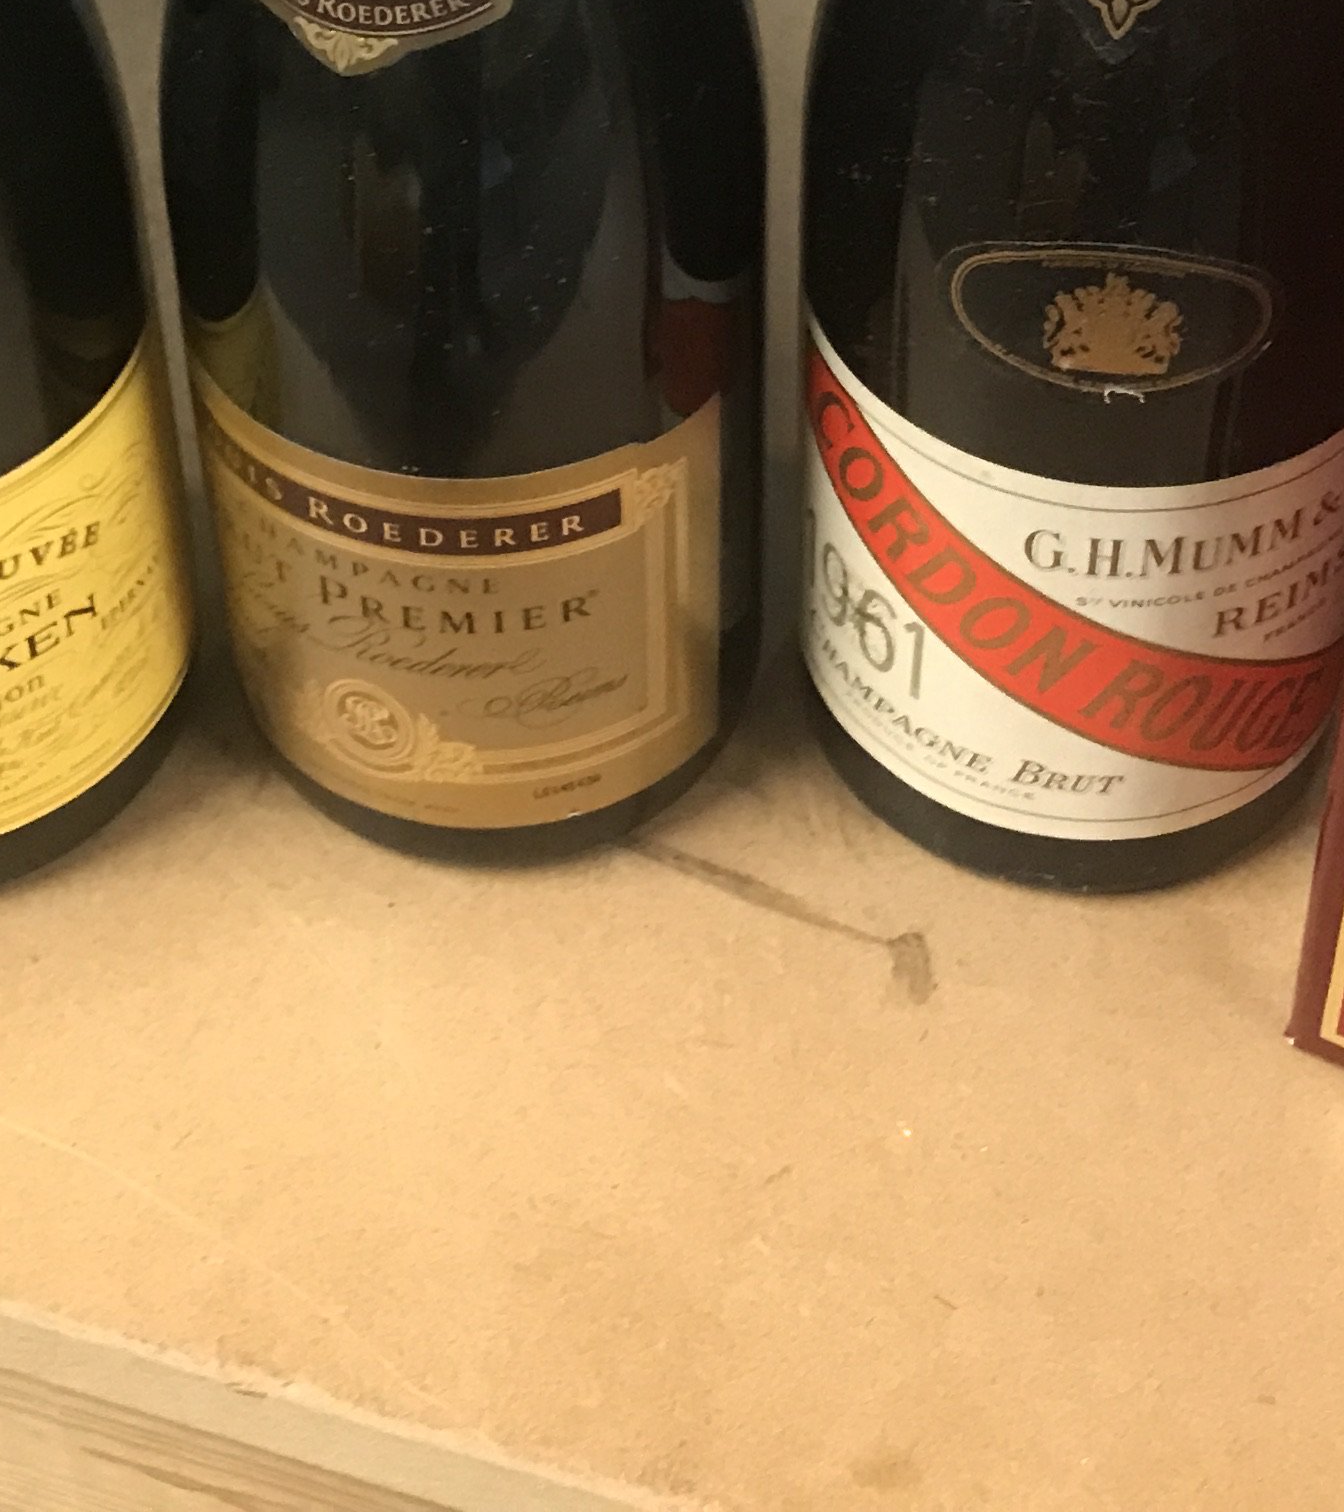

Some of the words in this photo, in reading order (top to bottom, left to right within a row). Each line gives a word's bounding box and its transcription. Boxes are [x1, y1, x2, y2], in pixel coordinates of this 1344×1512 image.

[306, 495, 586, 549] ROEDERER
[1023, 508, 1304, 579] G.H.MUMM
[818, 391, 1098, 699] CORDON
[1080, 658, 1324, 754] ROUGE
[1107, 589, 1205, 609] VINICOLE
[317, 574, 592, 636] PREMIER
[816, 538, 927, 701] 961
[1010, 756, 1126, 797] BRUT
